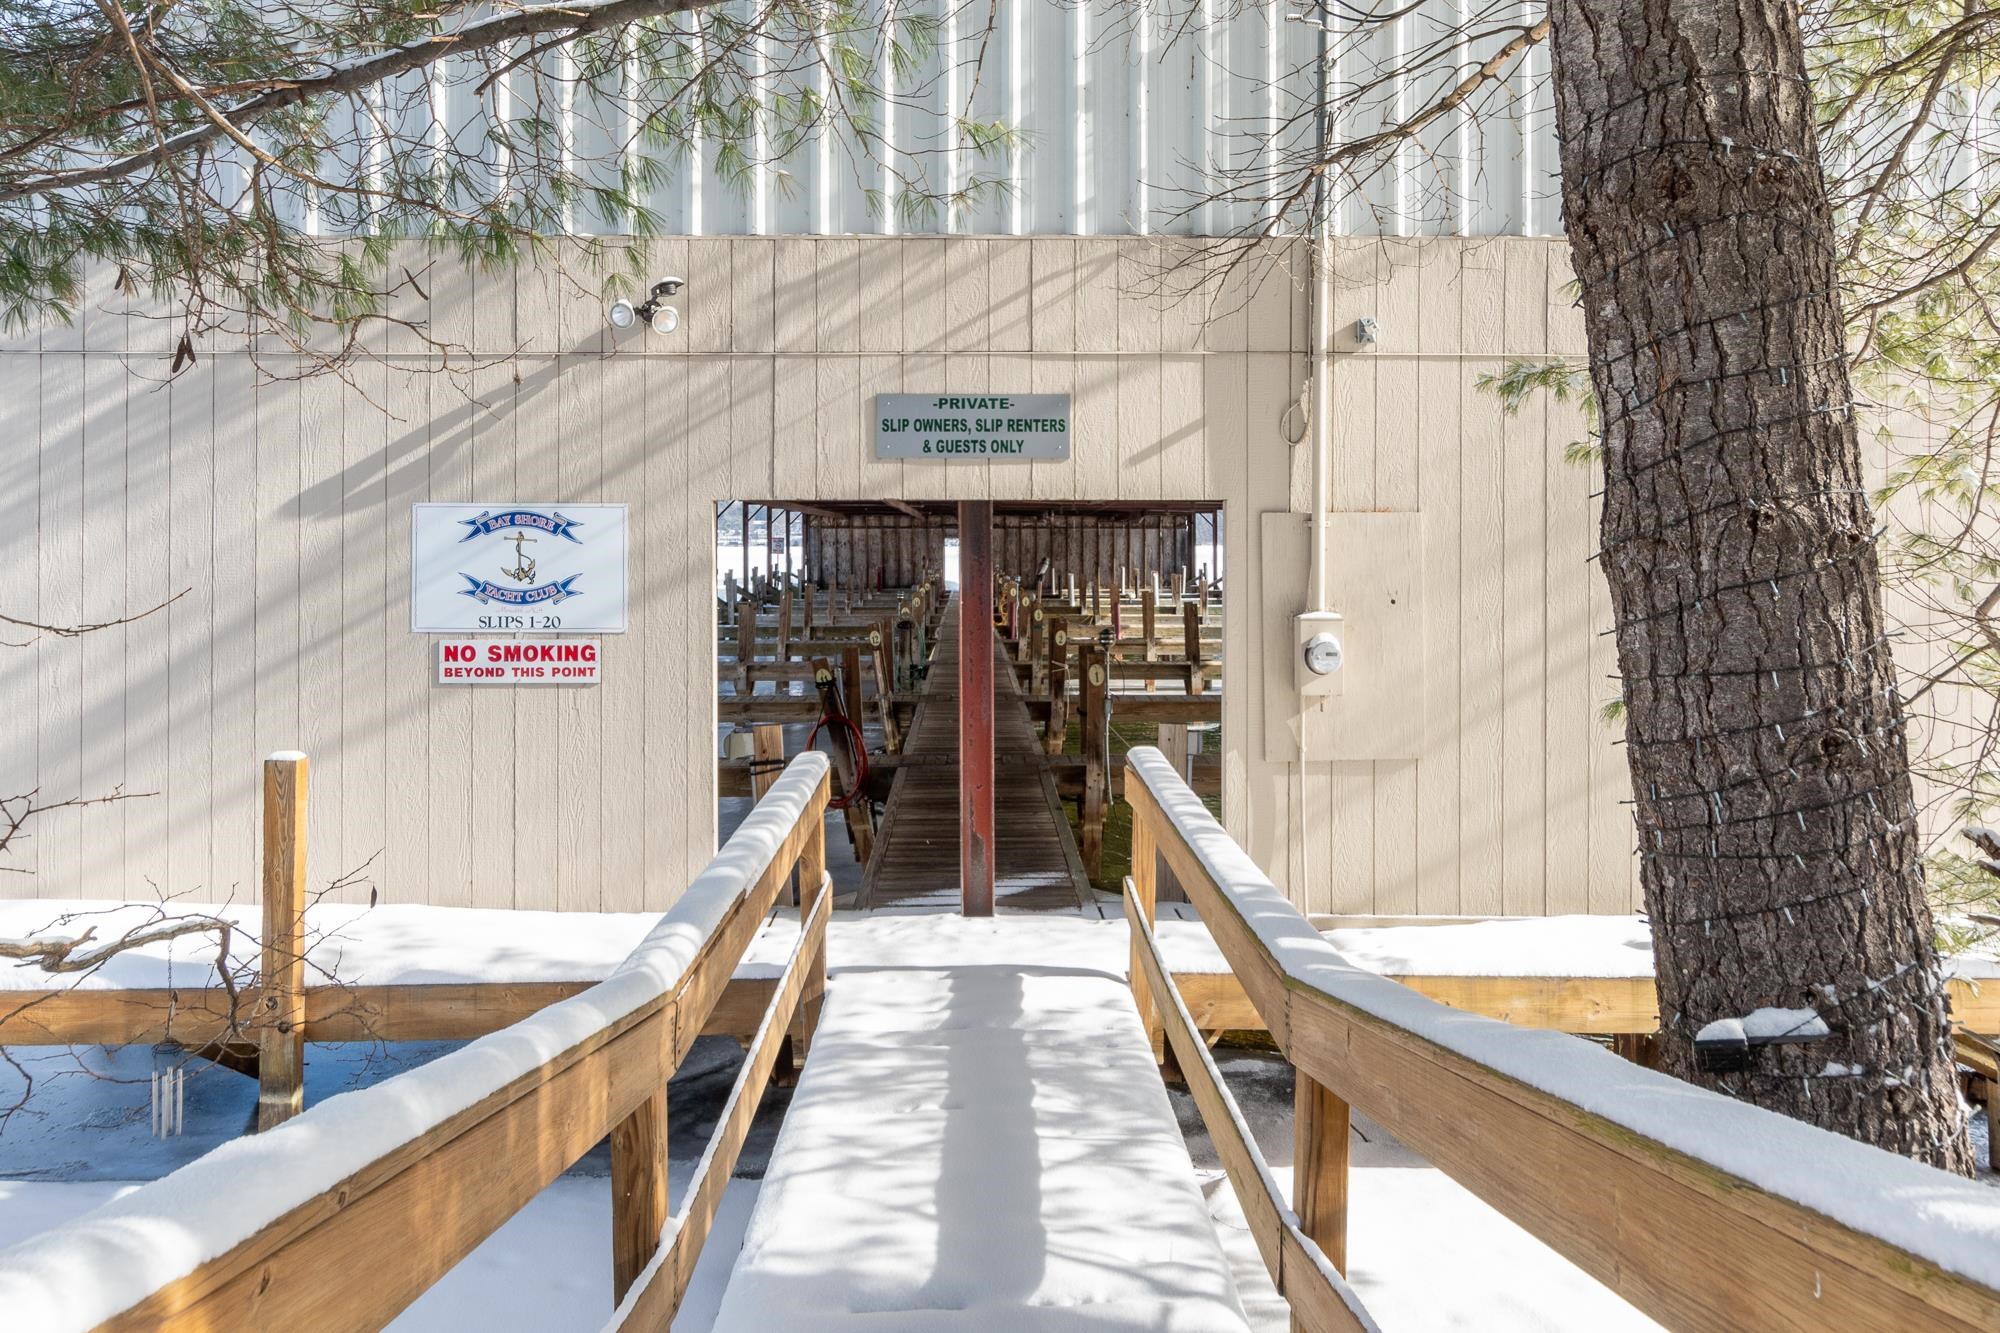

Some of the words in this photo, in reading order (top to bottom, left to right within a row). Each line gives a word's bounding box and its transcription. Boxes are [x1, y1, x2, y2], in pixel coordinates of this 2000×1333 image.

[933, 398, 1014, 409] -PRIVATE-
[882, 419, 909, 432] SLIP
[914, 419, 971, 434] OWNERS,
[976, 419, 1002, 432] SLIP
[1007, 419, 1065, 432] RENTERS
[923, 440, 931, 453] &
[936, 440, 986, 453] GUESTS
[991, 440, 1024, 453] ONLY
[488, 516, 511, 530] BAY
[514, 514, 555, 530] SHORE
[486, 585, 523, 602] YACHT
[525, 586, 557, 602] CLUB
[479, 616, 523, 628] SLIPS
[530, 616, 561, 628] 1-20
[445, 646, 476, 662] NO
[488, 645, 595, 662] SMOKING
[445, 667, 504, 677] BEYOND
[512, 667, 544, 677] THIS
[552, 667, 596, 677] POINT
